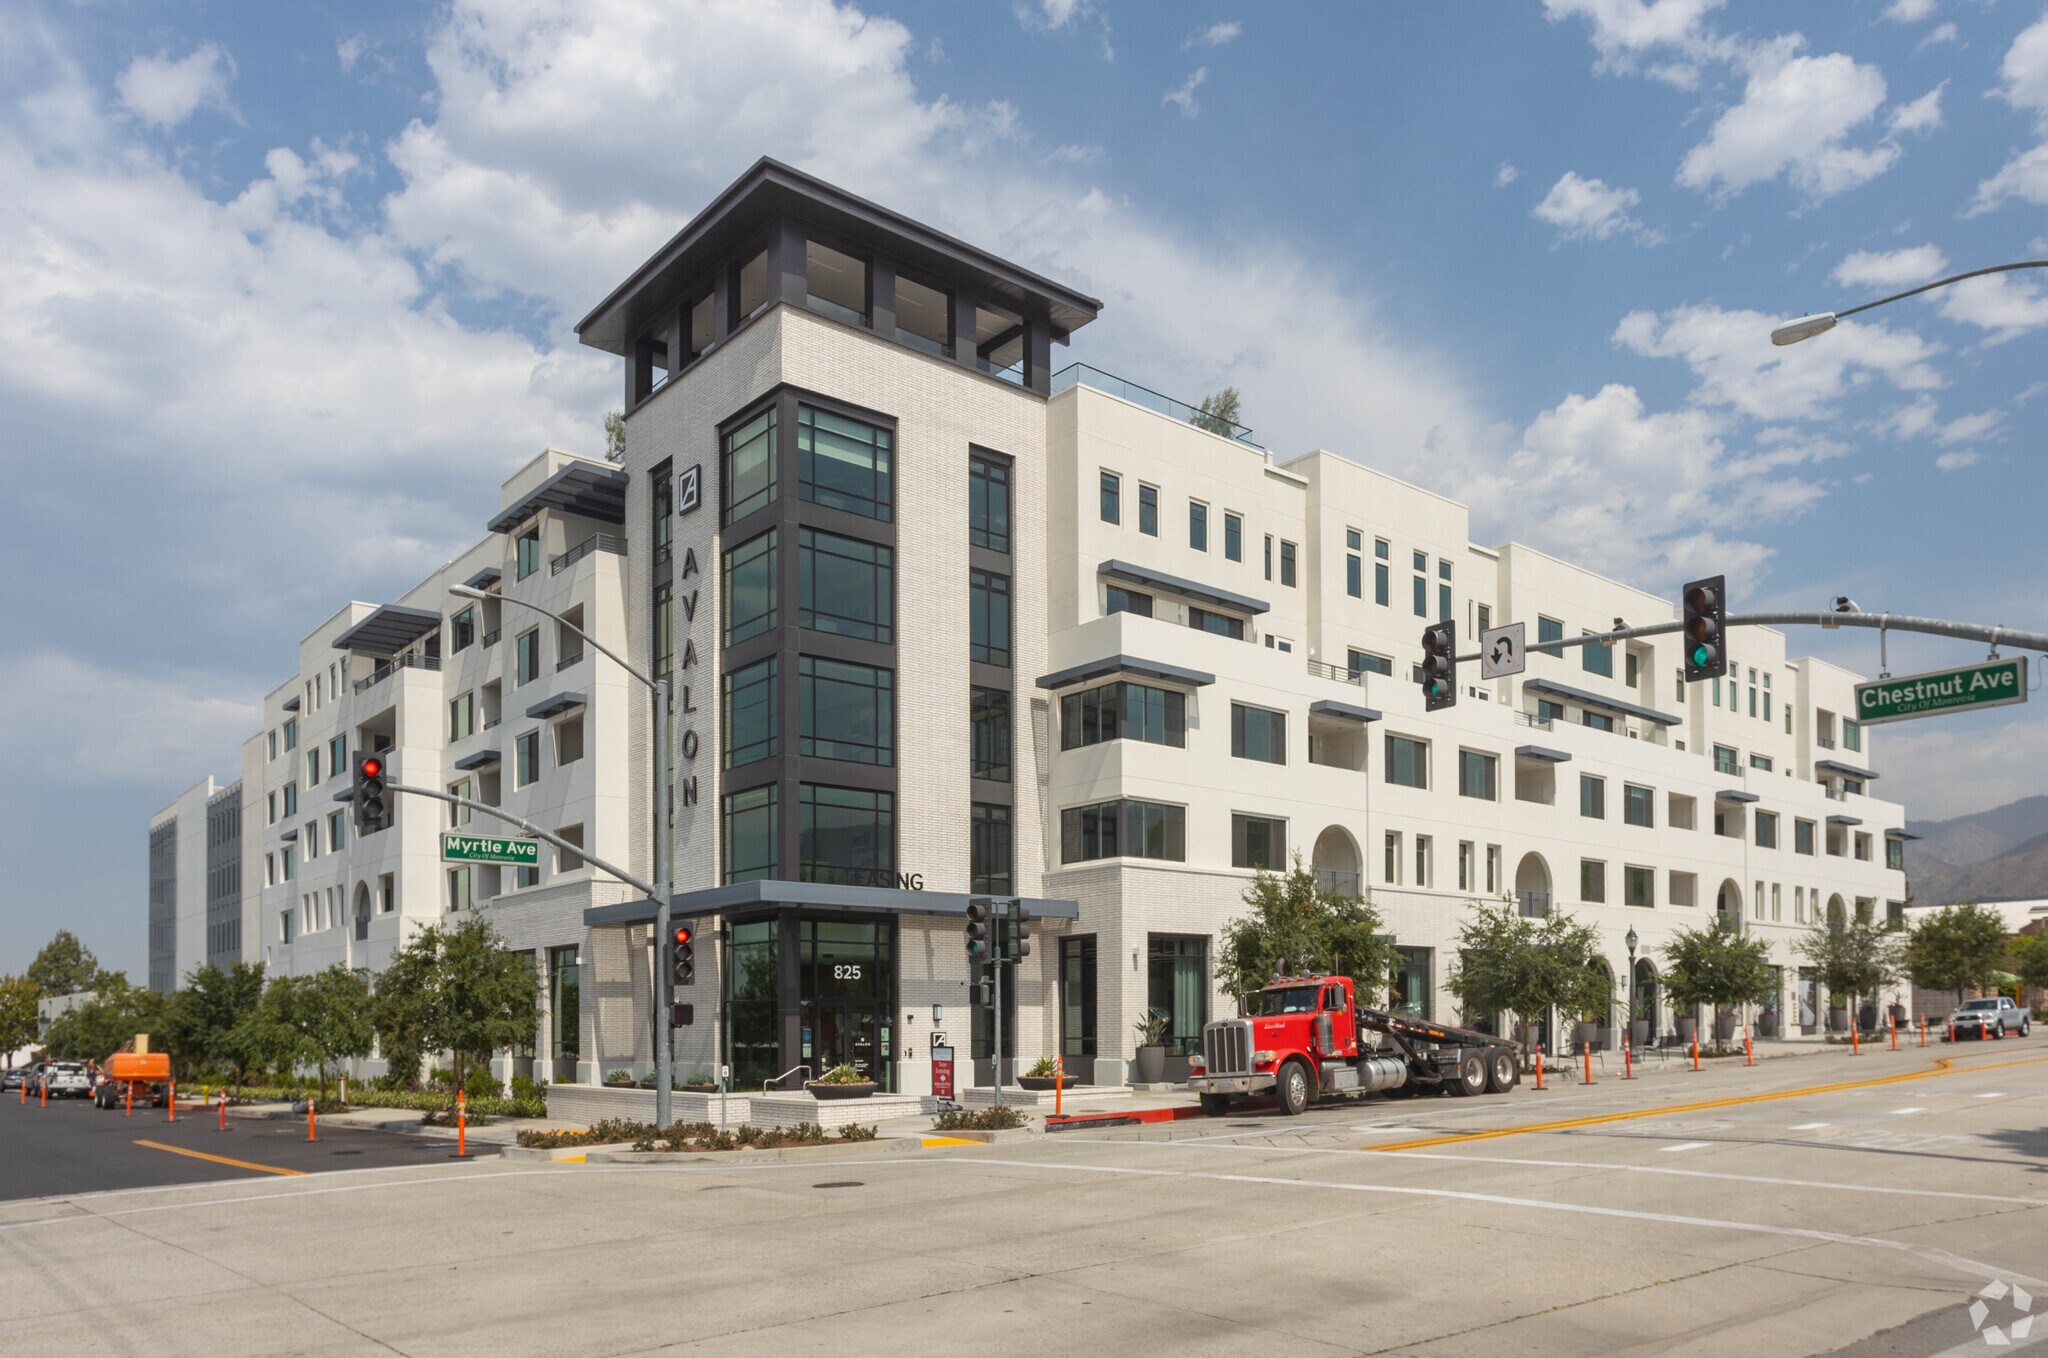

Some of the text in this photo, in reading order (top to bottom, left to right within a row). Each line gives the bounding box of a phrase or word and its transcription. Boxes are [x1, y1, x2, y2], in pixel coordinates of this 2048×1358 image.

[681, 547, 699, 805] AVALON
[1861, 671, 2014, 708] Chestnut Ave
[1897, 694, 1976, 712] City Of Monrovia
[447, 837, 536, 855] Myrtle Ave
[847, 869, 924, 891] EASNG
[834, 965, 861, 980] 825
